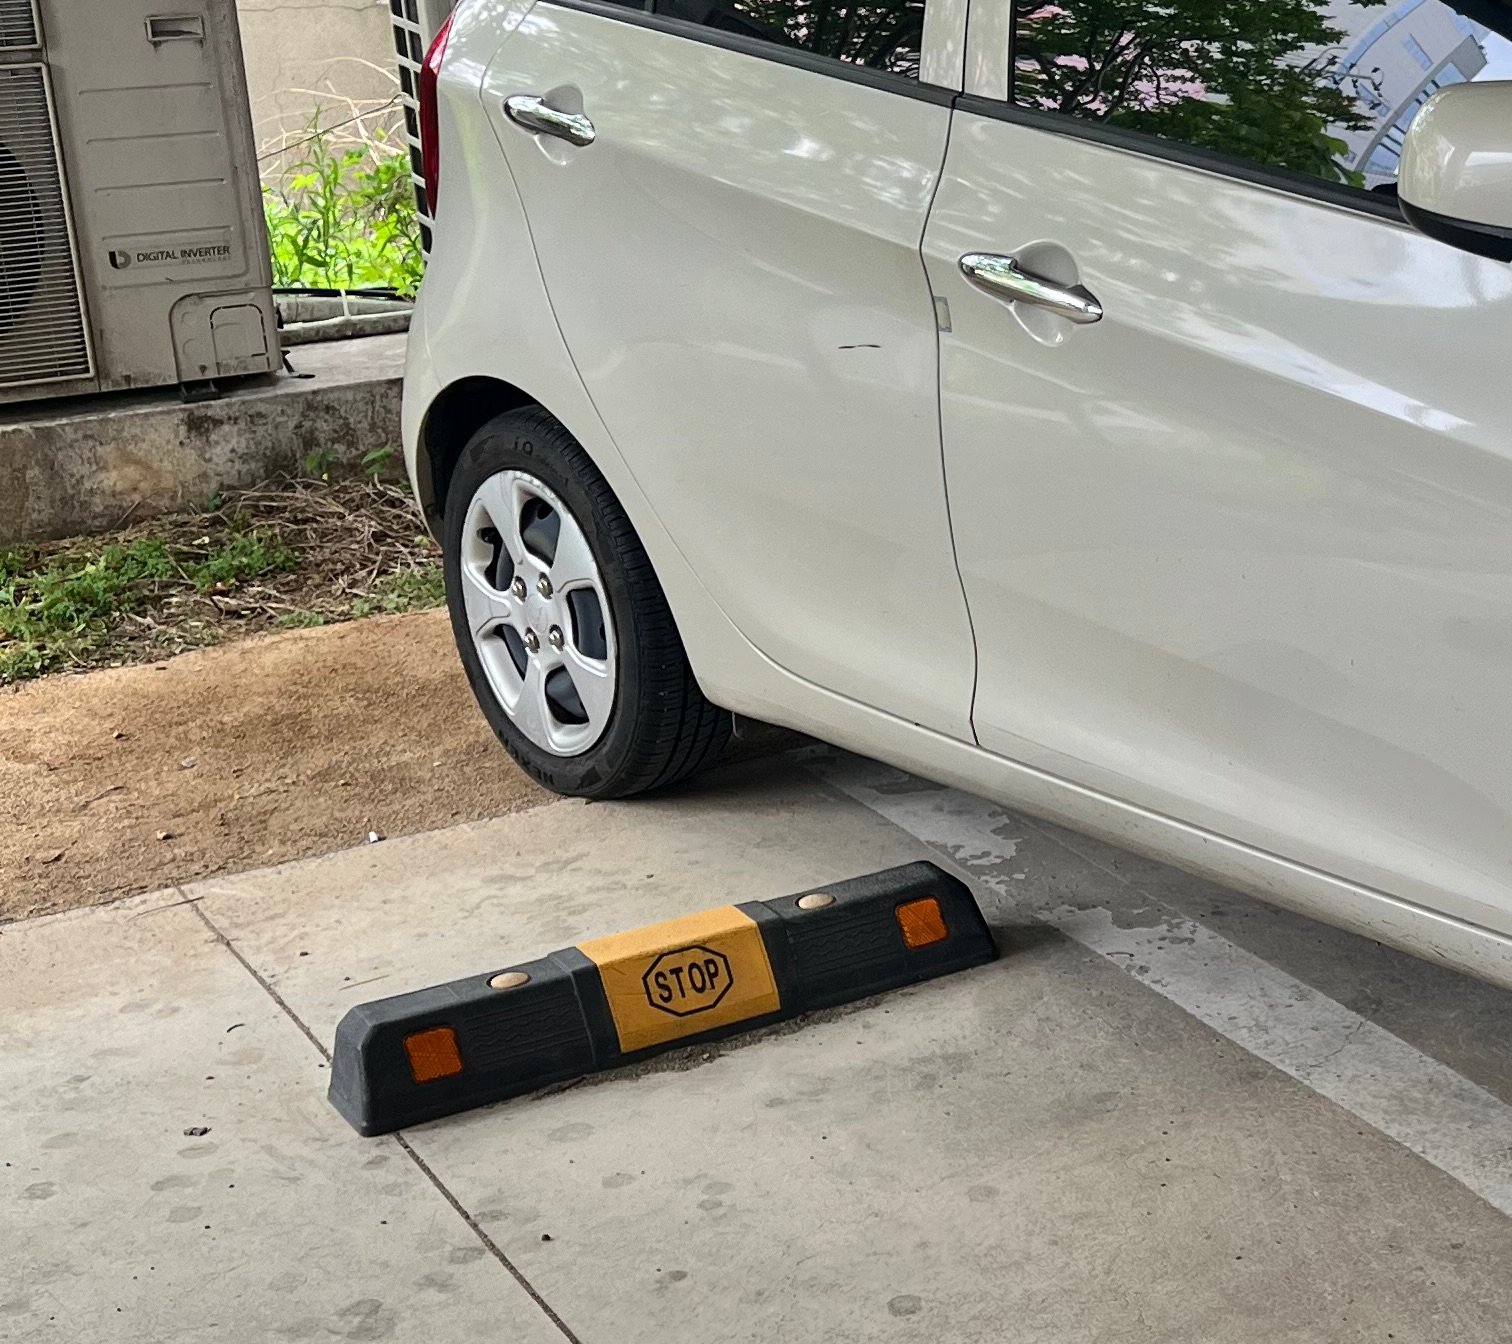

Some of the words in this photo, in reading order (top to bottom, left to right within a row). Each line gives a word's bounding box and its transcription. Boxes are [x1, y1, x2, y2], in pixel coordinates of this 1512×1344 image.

[137, 249, 179, 262] DIGITAL
[180, 245, 231, 258] INVERTER
[654, 958, 719, 1004] STOP
